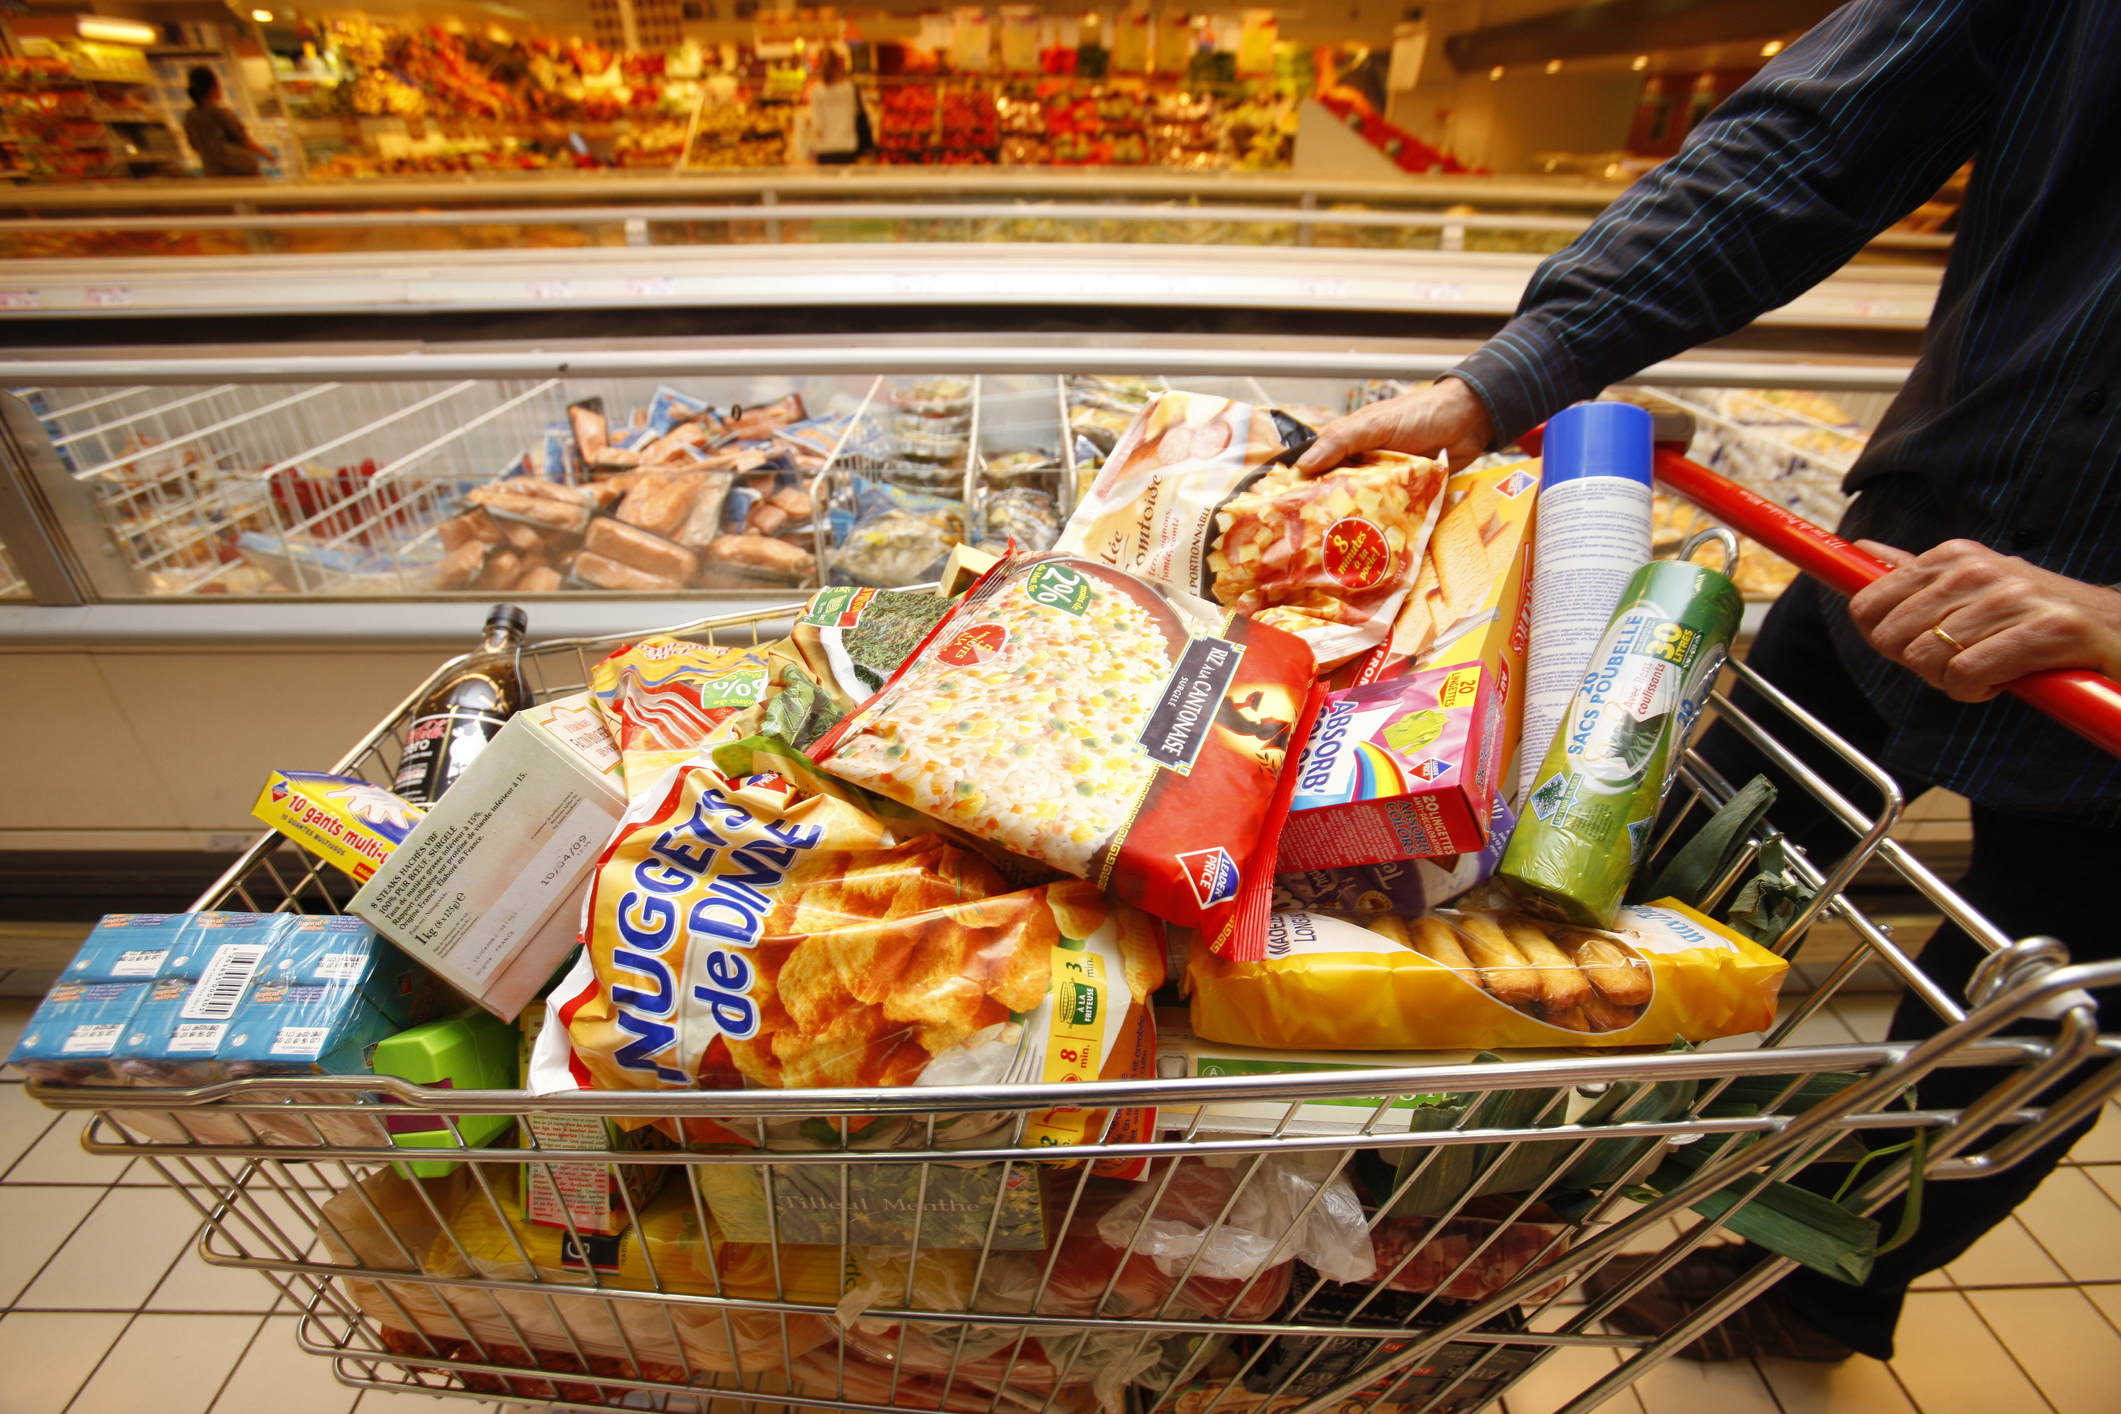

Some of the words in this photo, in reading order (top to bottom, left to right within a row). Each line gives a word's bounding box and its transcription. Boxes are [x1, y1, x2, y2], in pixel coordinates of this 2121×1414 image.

[1126, 474, 1162, 571] omtoise
[1160, 508, 1172, 549] oignons,
[1157, 550, 1174, 583] fumée,
[1171, 517, 1181, 547] comté
[1189, 505, 1212, 589] PORTIONNABLE
[1333, 534, 1350, 554] 8
[1338, 531, 1367, 575] minutes
[1359, 548, 1370, 561] la
[1037, 567, 1081, 603] 2%
[977, 639, 994, 654] 5
[1205, 646, 1228, 667] RIZ
[1645, 622, 1684, 660] 30
[1672, 629, 1694, 663] LITRES
[713, 697, 730, 706] de
[1444, 672, 1462, 708] LINGETTES
[1459, 679, 1476, 694] 20
[1567, 709, 1600, 755] SACS
[1590, 616, 1645, 704] POUBELLE
[1578, 671, 1600, 698] 20
[1623, 685, 1643, 709] Avec
[1633, 662, 1652, 687] liens
[1638, 662, 1666, 716] coulissants
[1161, 681, 1212, 757] CANTONAISE
[1676, 699, 1694, 728] 20
[1422, 760, 1431, 777] PRICE
[1566, 791, 1573, 799] EN
[1570, 774, 1581, 792] VERT
[288, 795, 308, 813] 10
[302, 806, 344, 837] gants
[1422, 795, 1440, 811] 20
[288, 817, 314, 837] GUANTES
[313, 833, 346, 856] MULTIUSOS
[1384, 802, 1419, 855] COLORS
[1430, 808, 1457, 855] LINGETTES
[384, 905, 402, 922] Taux
[399, 896, 408, 908] de
[406, 875, 428, 898] matière
[425, 859, 445, 881] grasse
[442, 831, 466, 858] inférieur
[463, 824, 470, 834] à
[467, 810, 485, 827] 15%.
[392, 900, 417, 926] Rapport
[413, 873, 439, 903] collagène
[437, 863, 449, 876] sur
[446, 839, 470, 869] protéine
[467, 830, 477, 841] de
[474, 811, 493, 832] viande
[491, 786, 515, 813] inférieur
[516, 771, 529, 783] 15.
[370, 902, 378, 910] 8
[376, 874, 403, 904] STEAKS
[398, 845, 429, 876] HACHÉS
[424, 830, 440, 850] VBF
[378, 895, 399, 915] 100%
[396, 879, 412, 897] PUR
[409, 857, 432, 881] BŒUF.
[428, 824, 458, 857] SURGELÉ
[399, 906, 421, 931] Origine
[419, 889, 440, 911] France.
[436, 863, 459, 888] Élaboré
[457, 855, 467, 865] en
[464, 835, 486, 858] France.
[690, 819, 823, 943] DINDE
[1200, 854, 1217, 889] PRICE
[1214, 857, 1230, 897] LEADER
[611, 787, 753, 1084] NUGGETS
[1066, 961, 1083, 973] 3
[1087, 957, 1095, 978] min.
[693, 950, 757, 1036] de
[1078, 1006, 1086, 1014] À
[1079, 994, 1087, 1005] LA
[1084, 987, 1095, 1023] FRITEUSE
[1060, 1048, 1078, 1063] 8
[1080, 1044, 1091, 1068] min.
[1132, 1060, 1139, 1069] et
[779, 1195, 868, 1212] Tilleul
